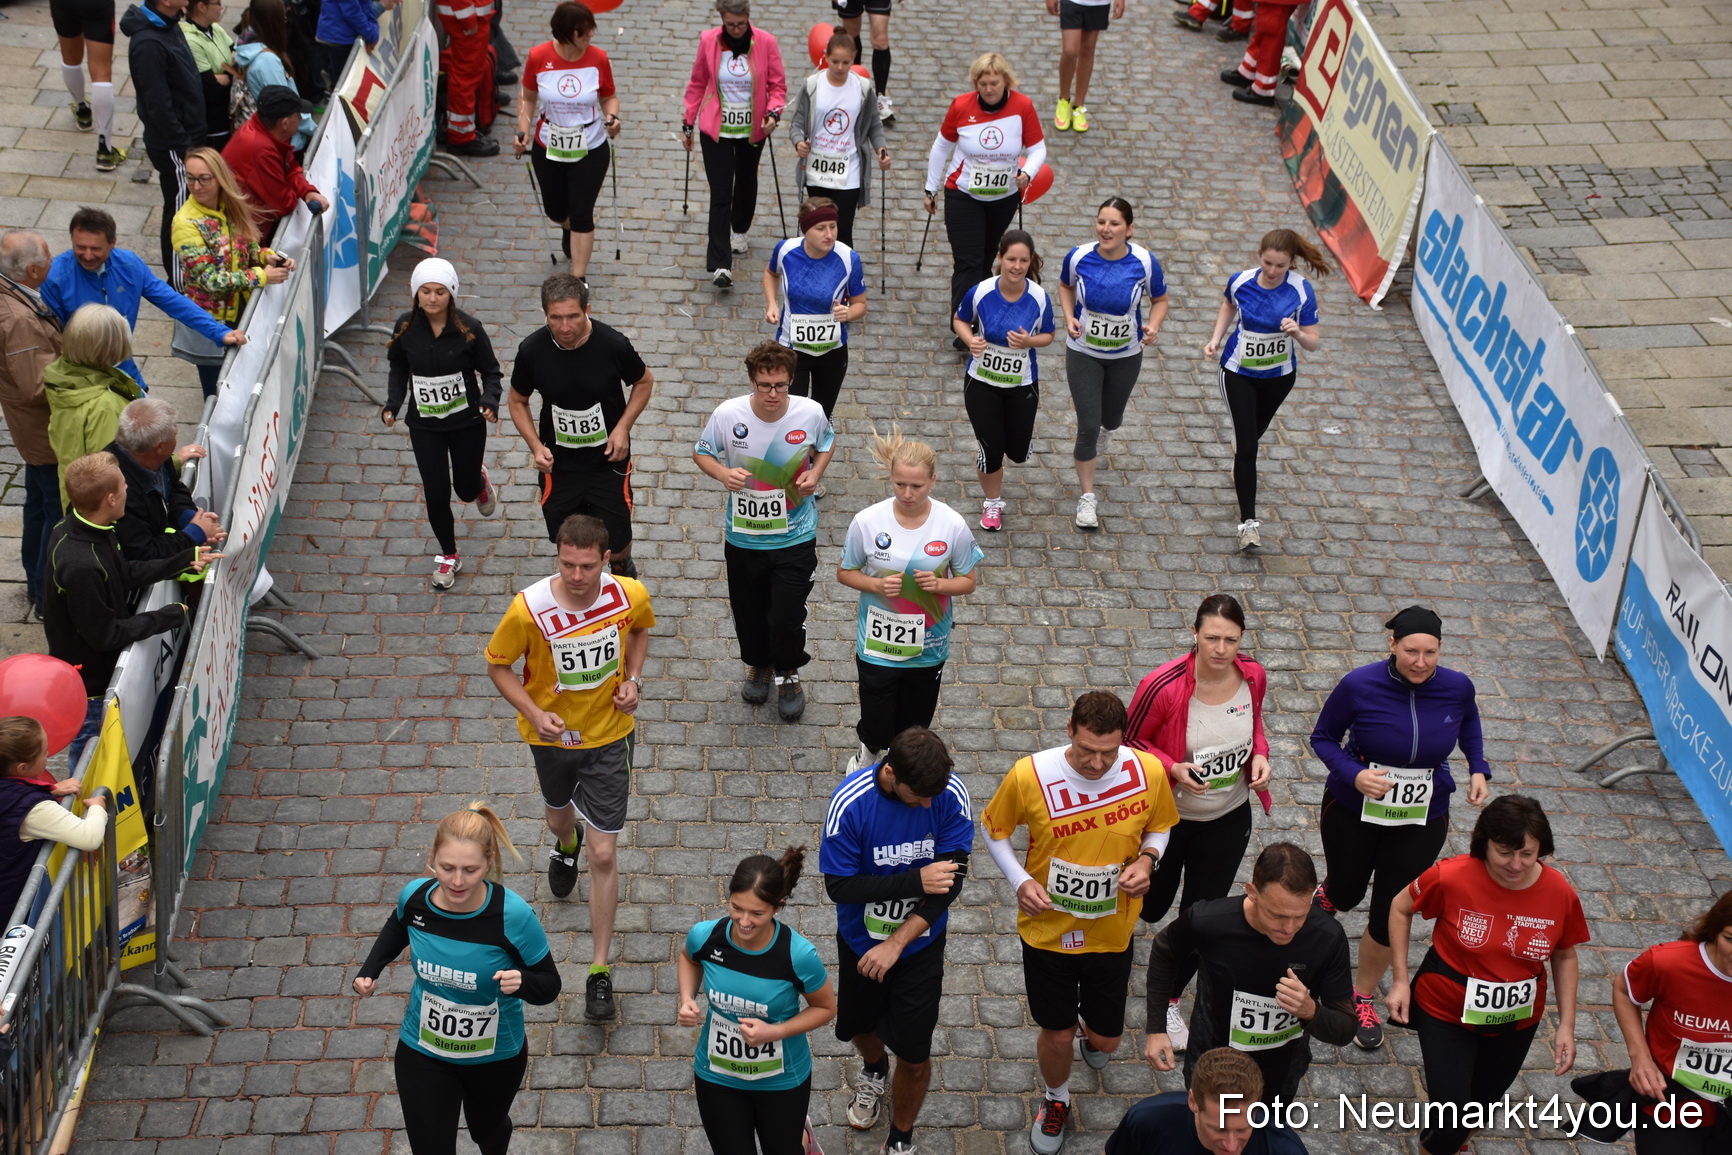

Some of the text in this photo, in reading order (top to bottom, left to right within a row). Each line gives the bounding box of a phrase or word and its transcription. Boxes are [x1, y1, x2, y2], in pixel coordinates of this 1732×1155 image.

[551, 134, 582, 149] 5177
[812, 158, 845, 175] 4048
[974, 172, 1008, 187] 5140
[797, 325, 835, 343] 5027
[1090, 319, 1130, 338] 5142
[1097, 339, 1120, 347] Sophie
[1259, 334, 1284, 342] Neumarkt
[1417, 208, 1583, 475] slackstar
[802, 343, 831, 352] Christine
[997, 349, 1020, 358] Neumarkt
[1245, 339, 1285, 358] 5046
[982, 353, 1023, 374] 5059
[1255, 358, 1274, 366] Sonja
[430, 379, 455, 388] Neumarkt
[985, 370, 1014, 383] Franziska
[419, 384, 461, 404] 5184
[571, 409, 595, 419] Neumarkt
[558, 416, 601, 435] 5183
[567, 436, 596, 445] Andreas
[751, 493, 776, 501] Neumarkt
[738, 498, 782, 519] 5049
[745, 520, 773, 529] Manuel
[869, 609, 915, 625] PARTL Neumarkt
[872, 618, 917, 644] 5121
[553, 634, 609, 651] PARTL Neumarkt
[882, 645, 902, 655] Julia
[1621, 596, 1646, 636] AUF
[1641, 627, 1672, 689] JEDER
[561, 641, 615, 672] 5176
[582, 672, 602, 684] Nico
[1194, 742, 1246, 762] PARTL Neumarkt
[1200, 748, 1249, 779] 5302
[1393, 773, 1424, 782] Neumarkt
[1377, 782, 1428, 804] 182
[1053, 798, 1150, 840] MAX BÖGL
[1384, 808, 1409, 818] Heike
[873, 838, 935, 862] HUBER
[1051, 861, 1110, 878] PARTL Neumarkt
[1055, 873, 1112, 899] 5201
[1061, 898, 1103, 912] Christian
[1462, 920, 1488, 931] WIEDER
[1463, 915, 1488, 925] IMMER
[1513, 920, 1548, 930] STADTLAUF
[1516, 915, 1555, 926] NEUMARKTER
[1460, 933, 1483, 944] MARKT
[1461, 926, 1485, 939] NEU
[417, 958, 478, 985] HUBER
[427, 974, 476, 990] TECHNOLOGY
[709, 988, 769, 1014] HUBER
[1235, 996, 1263, 1008] PARTL
[1474, 983, 1532, 1009] 5063
[424, 996, 487, 1017] PARTL Neumarkt
[427, 1008, 493, 1038] 5037
[712, 1017, 732, 1033] PARTL
[1485, 1013, 1516, 1024] Christa
[1673, 1010, 1732, 1032] NEUMA
[434, 1036, 477, 1051] Stefanie
[715, 1030, 777, 1059] 5064
[1249, 1032, 1289, 1045] Andreas
[1683, 1043, 1712, 1053] PARTL
[731, 1059, 759, 1074] Sonja
[1701, 1080, 1732, 1098] Anita
